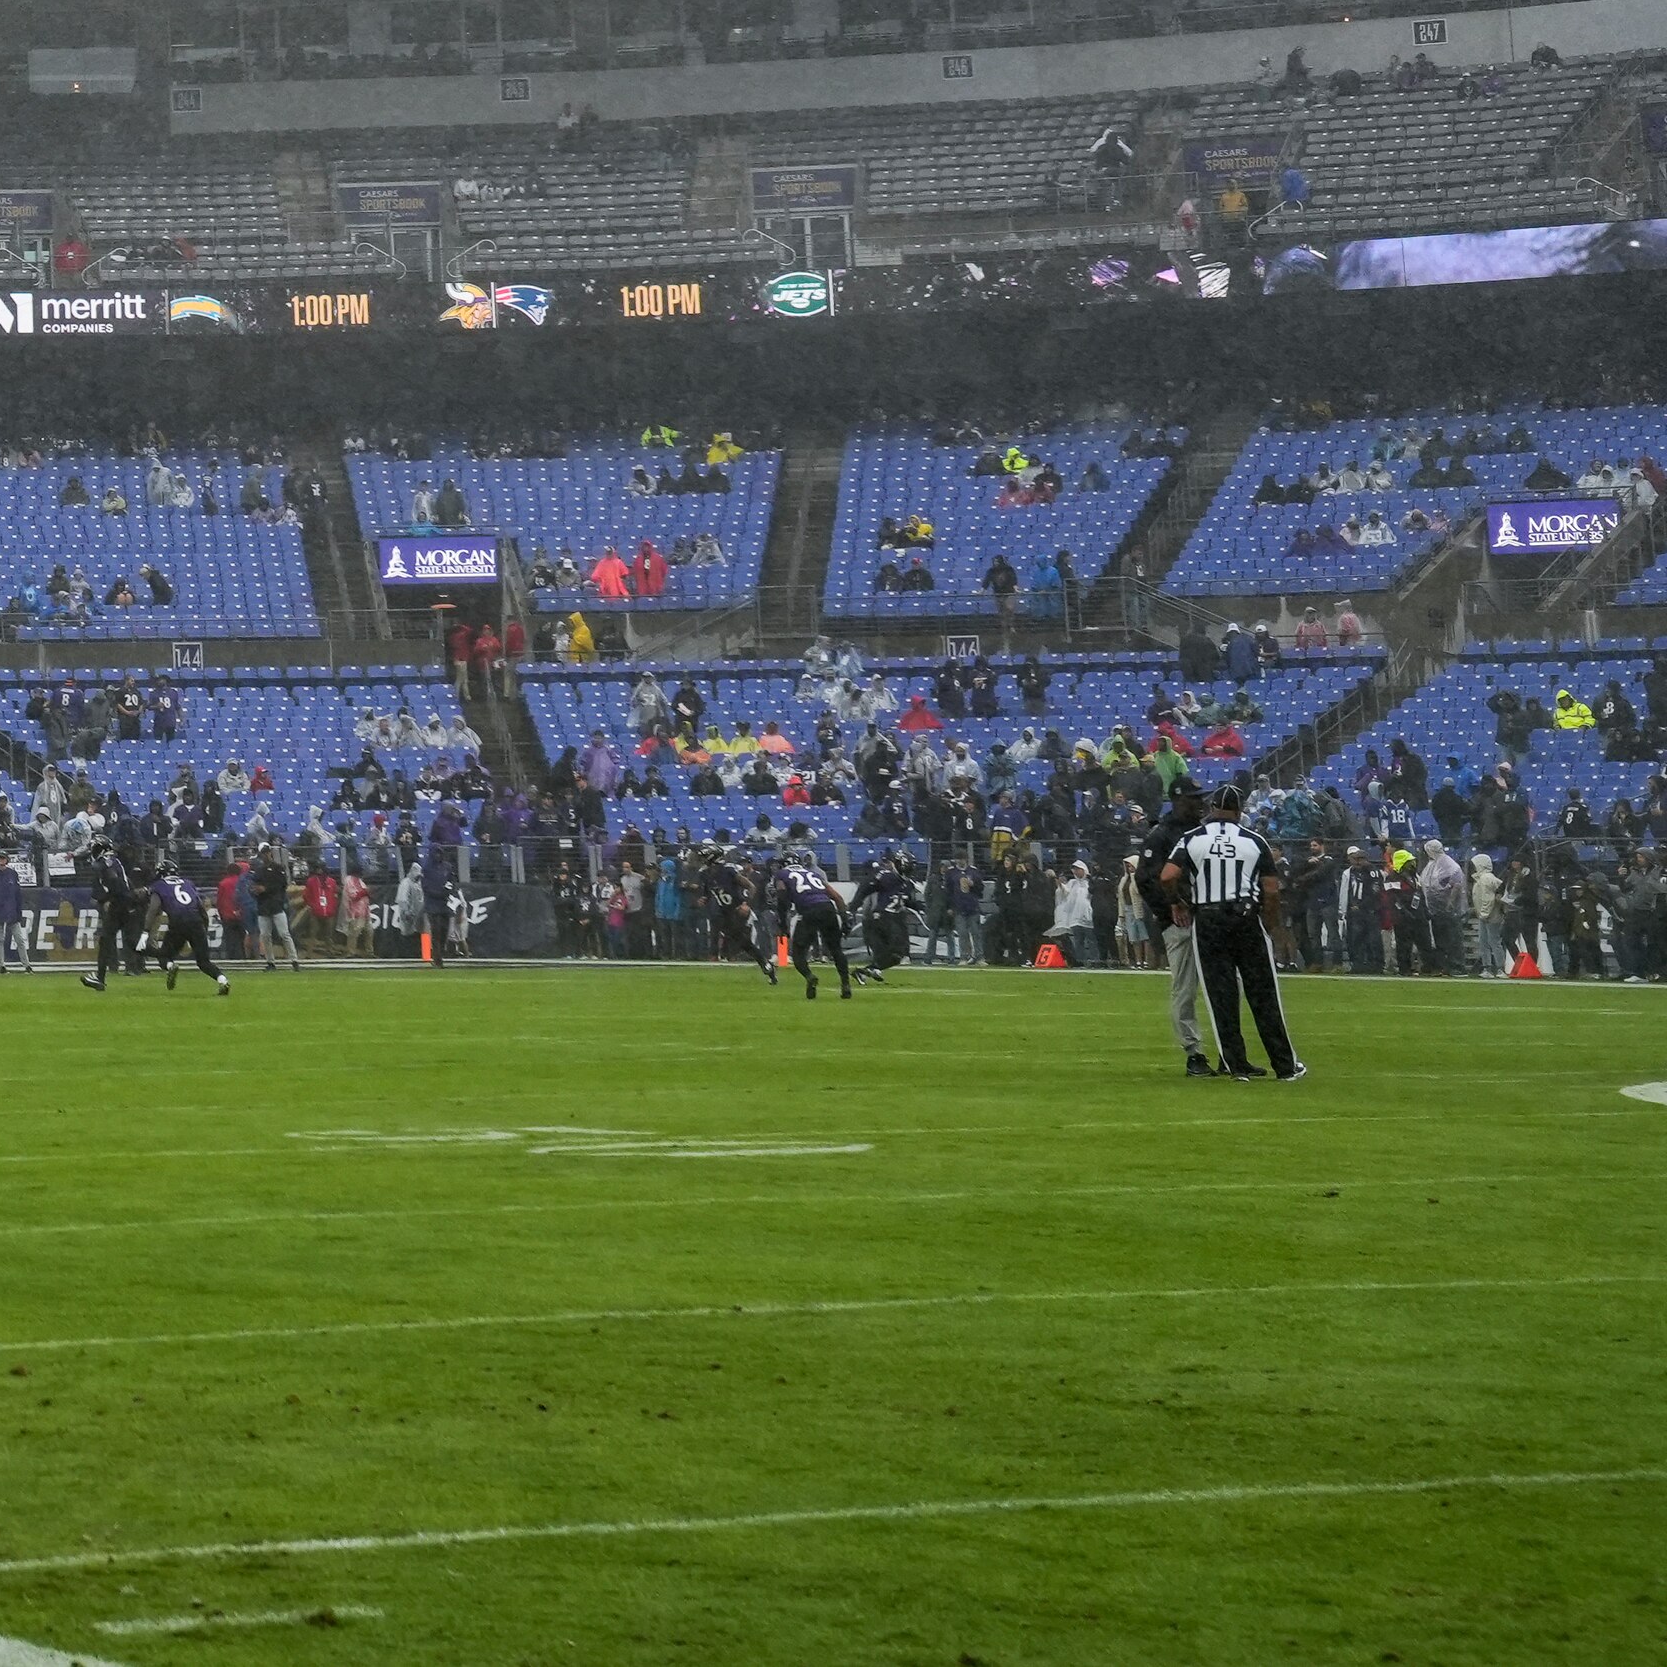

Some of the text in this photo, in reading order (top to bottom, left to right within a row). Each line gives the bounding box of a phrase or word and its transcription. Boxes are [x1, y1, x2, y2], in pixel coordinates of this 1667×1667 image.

[1204, 148, 1247, 158] CAESARS
[620, 283, 701, 317] 1:00 PM
[772, 288, 827, 302] JETS
[42, 293, 146, 320] merritt
[291, 293, 370, 325] 1:00 PM
[42, 323, 114, 334] COMPANIES
[1529, 532, 1557, 543] STATE
[415, 548, 494, 566] MORGAN
[415, 565, 496, 576] STATE UNIVERSITY
[174, 647, 200, 668] 144
[124, 694, 139, 707] 20
[1390, 808, 1405, 822] 18
[1214, 835, 1232, 845] FJ
[1209, 844, 1236, 859] 43
[794, 871, 825, 891] 26
[173, 884, 192, 905] 6
